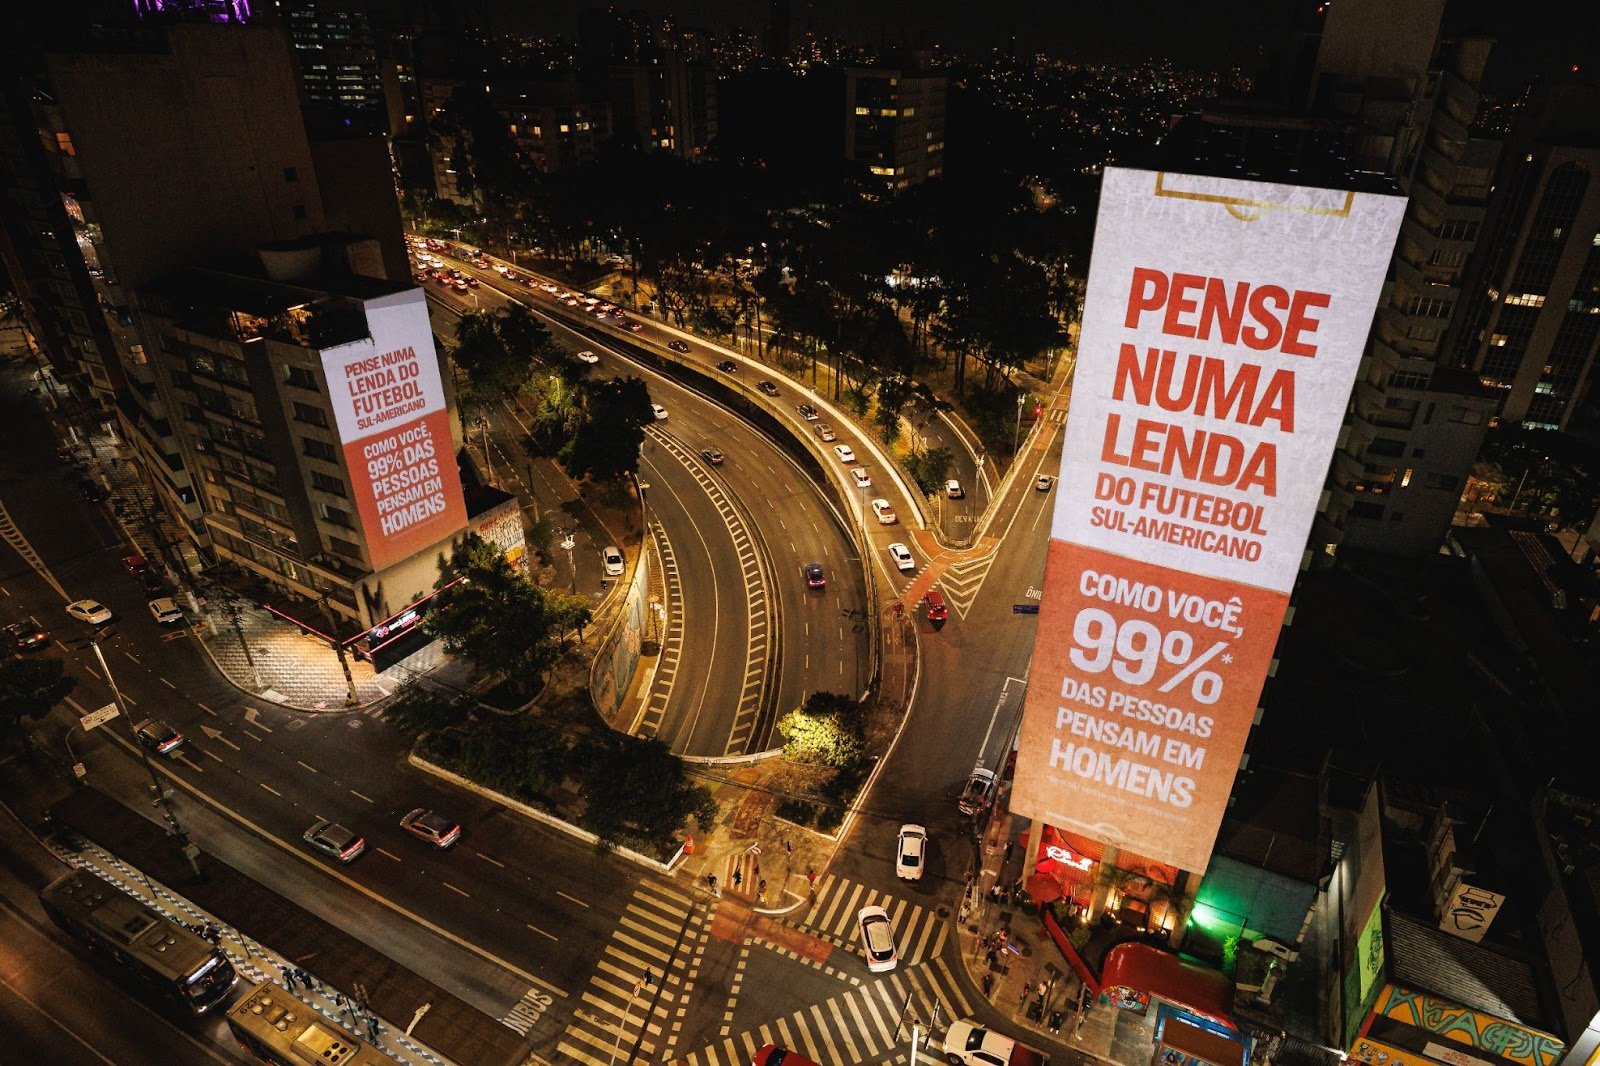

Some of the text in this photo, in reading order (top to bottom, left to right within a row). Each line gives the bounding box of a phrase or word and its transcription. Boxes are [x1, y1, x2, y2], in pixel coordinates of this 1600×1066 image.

[1125, 267, 1331, 358] PENSE
[345, 346, 415, 377] PENSE NUMA
[349, 362, 419, 397] LENDA DO
[353, 381, 423, 416] FUTEBOL
[1112, 344, 1294, 432] NUMA
[357, 398, 425, 429] SUL-AMERICANO
[364, 422, 431, 458] COMO VOCÊ,
[403, 438, 435, 466] DAS
[1101, 414, 1276, 496] LENDA
[372, 459, 438, 499] PESSOAS
[377, 477, 442, 514] PENSAM EM
[380, 492, 446, 535] HOMENS
[1096, 473, 1265, 535] DO FUTEBOL
[1092, 508, 1261, 561] SUL-AMERICANO
[1080, 570, 1243, 638] COMO VOCÊ,
[1062, 678, 1213, 737] DAS PESSOAS
[1056, 708, 1205, 770] PENSAM EM
[1050, 739, 1195, 808] HOMENS
